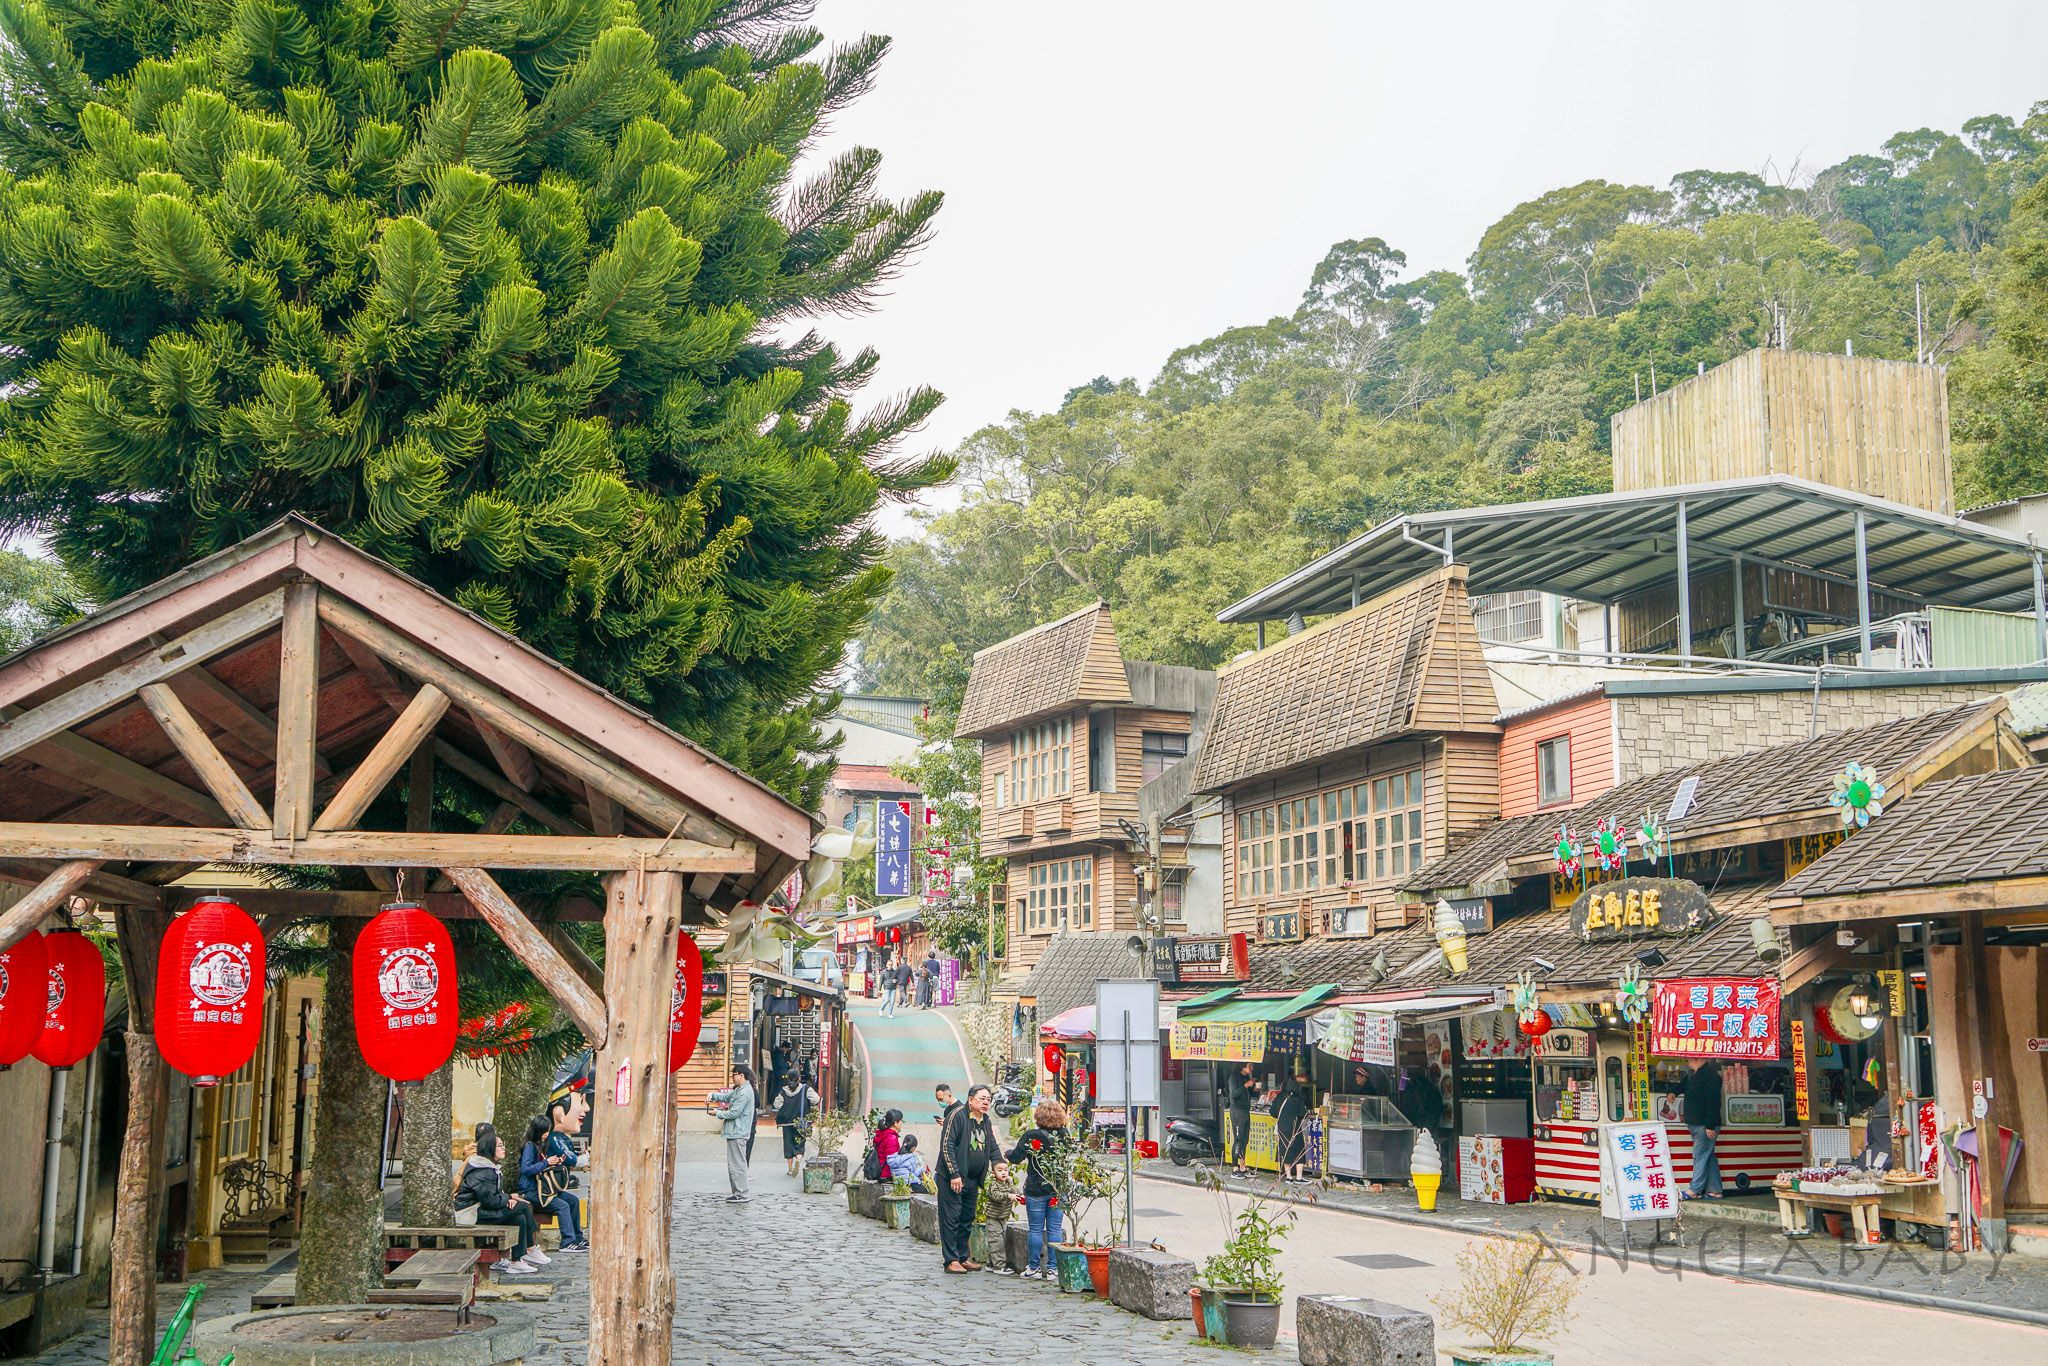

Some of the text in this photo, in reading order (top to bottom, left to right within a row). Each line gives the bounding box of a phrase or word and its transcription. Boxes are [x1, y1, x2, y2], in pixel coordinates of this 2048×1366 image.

[1676, 1013, 1769, 1038] 手工粄條
[1690, 985, 1759, 1009] 客家菜
[1792, 1024, 1808, 1116] 冷氣開放
[1618, 1134, 1647, 1211] 客家菜
[1640, 1132, 1670, 1210] 手工粄條
